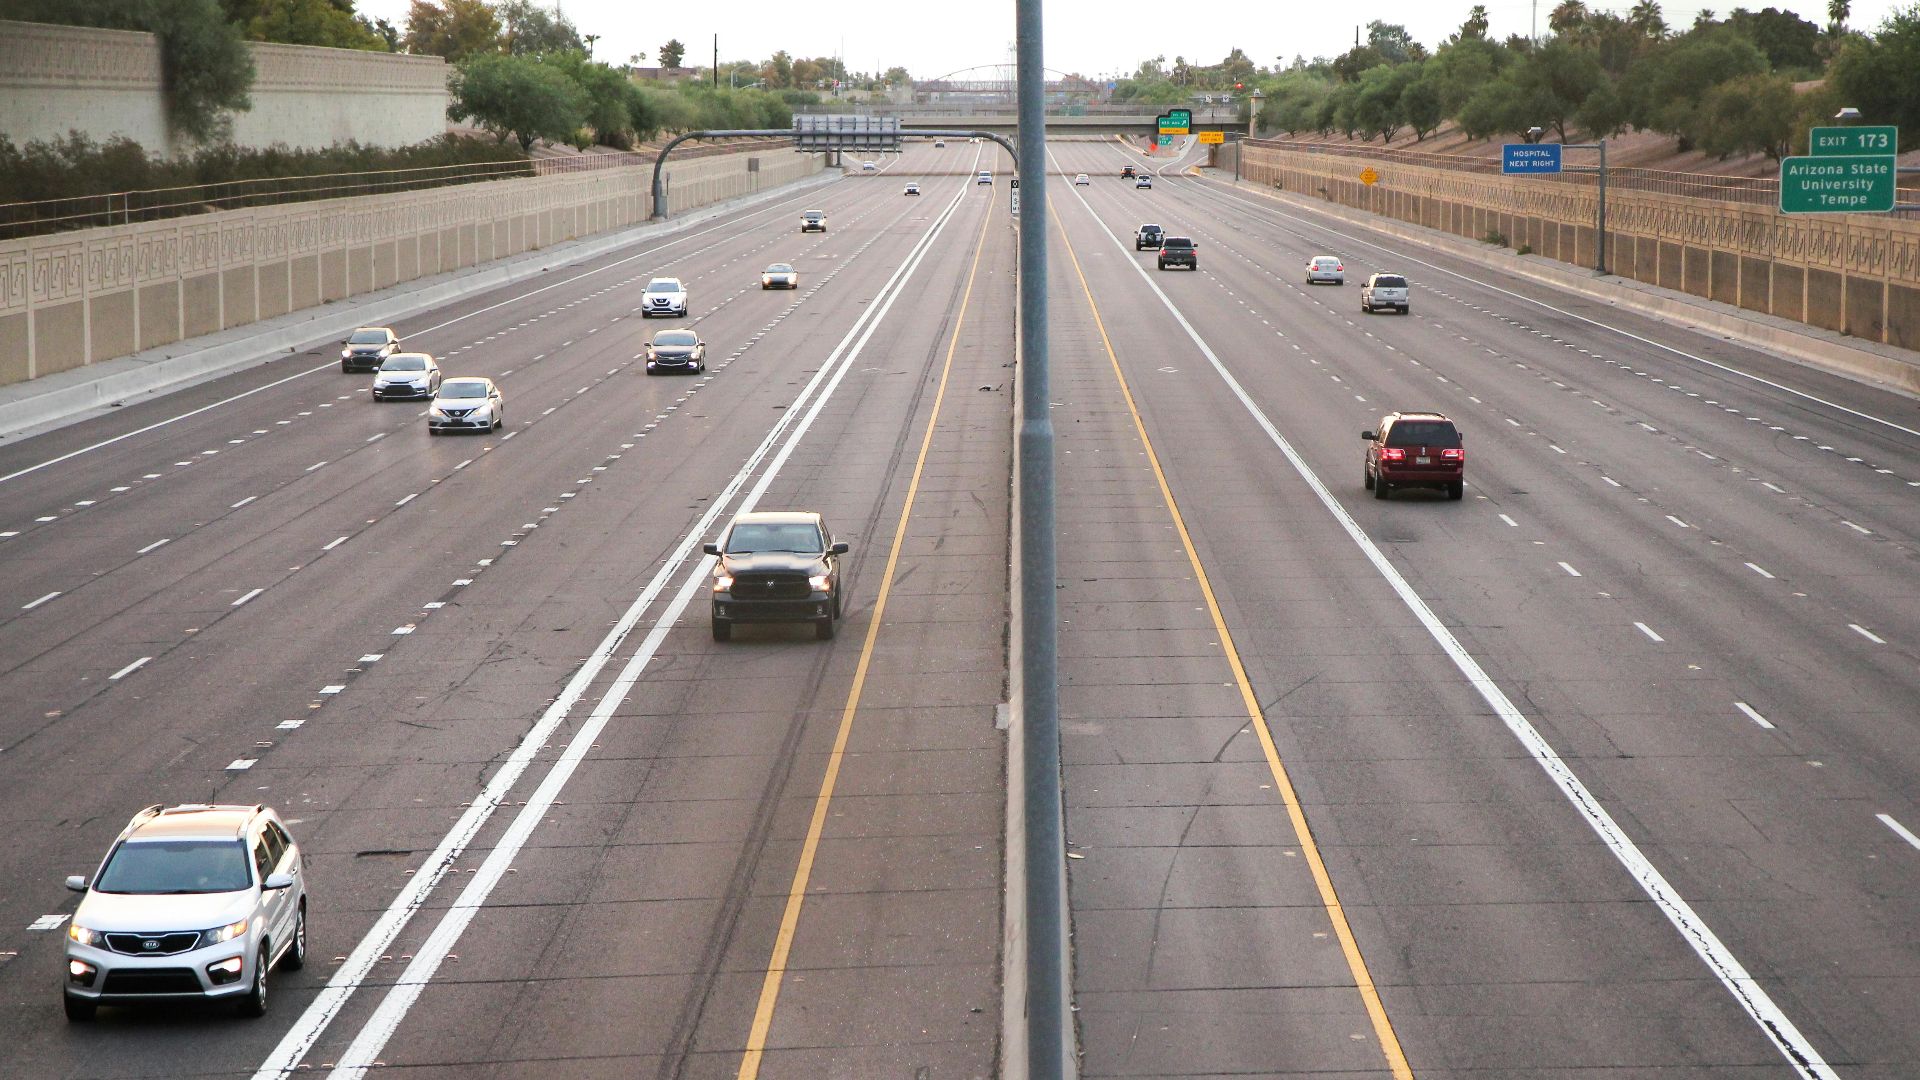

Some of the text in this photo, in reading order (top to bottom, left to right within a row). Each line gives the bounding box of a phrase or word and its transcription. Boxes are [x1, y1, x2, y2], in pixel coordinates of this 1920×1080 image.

[1819, 134, 1888, 148] EXIT 173
[1789, 163, 1888, 175] Arizona State
[1801, 178, 1874, 191] University
[1820, 194, 1868, 207] Tempe
